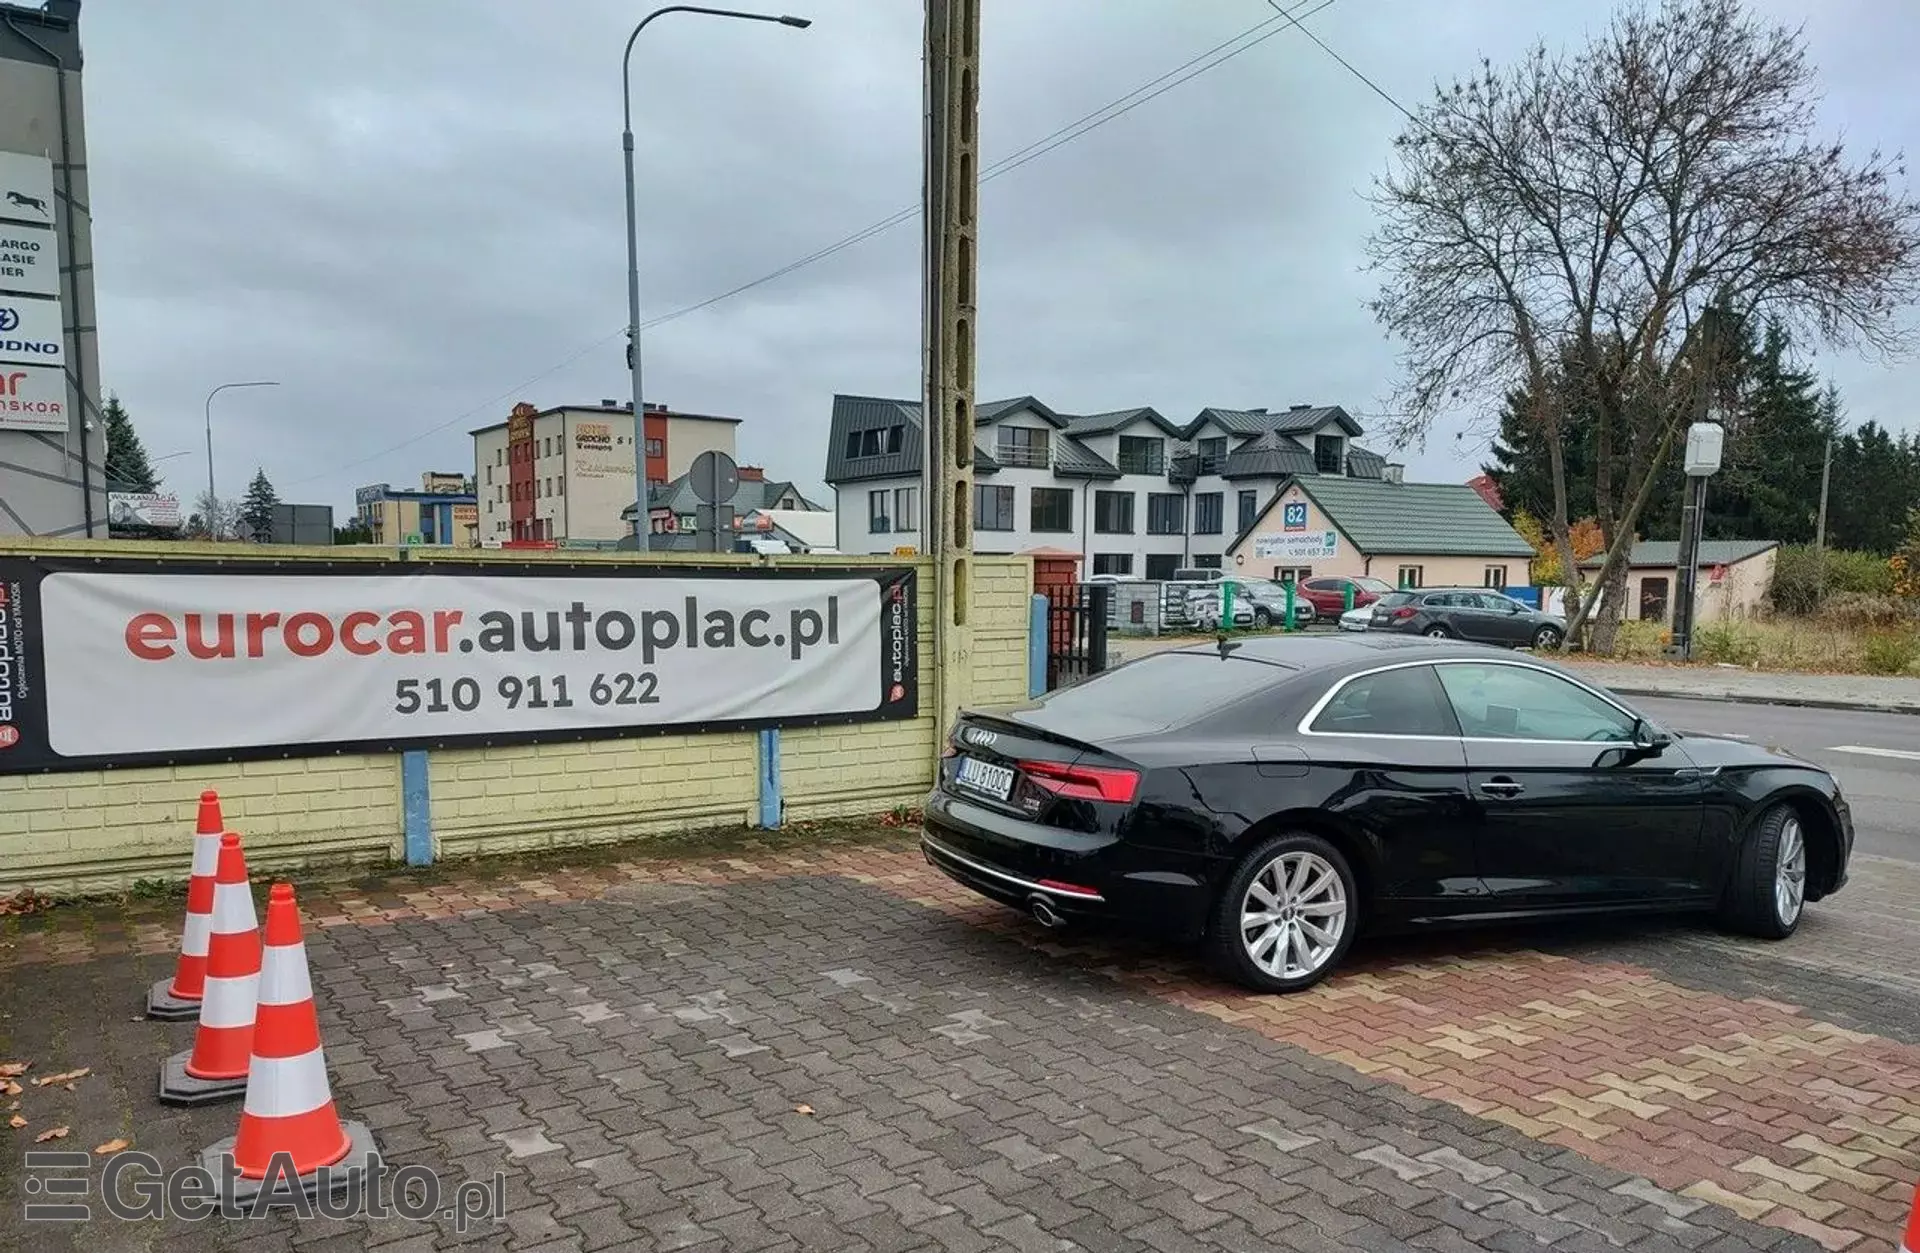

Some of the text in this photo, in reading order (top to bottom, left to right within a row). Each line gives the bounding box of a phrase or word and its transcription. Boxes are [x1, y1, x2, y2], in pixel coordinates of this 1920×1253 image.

[0, 340, 60, 355] DNO
[1287, 505, 1305, 523] 82
[14, 629, 24, 654] MOTO
[125, 595, 840, 664] eurocar.autoplac.pl
[395, 672, 660, 714] 510 911 622
